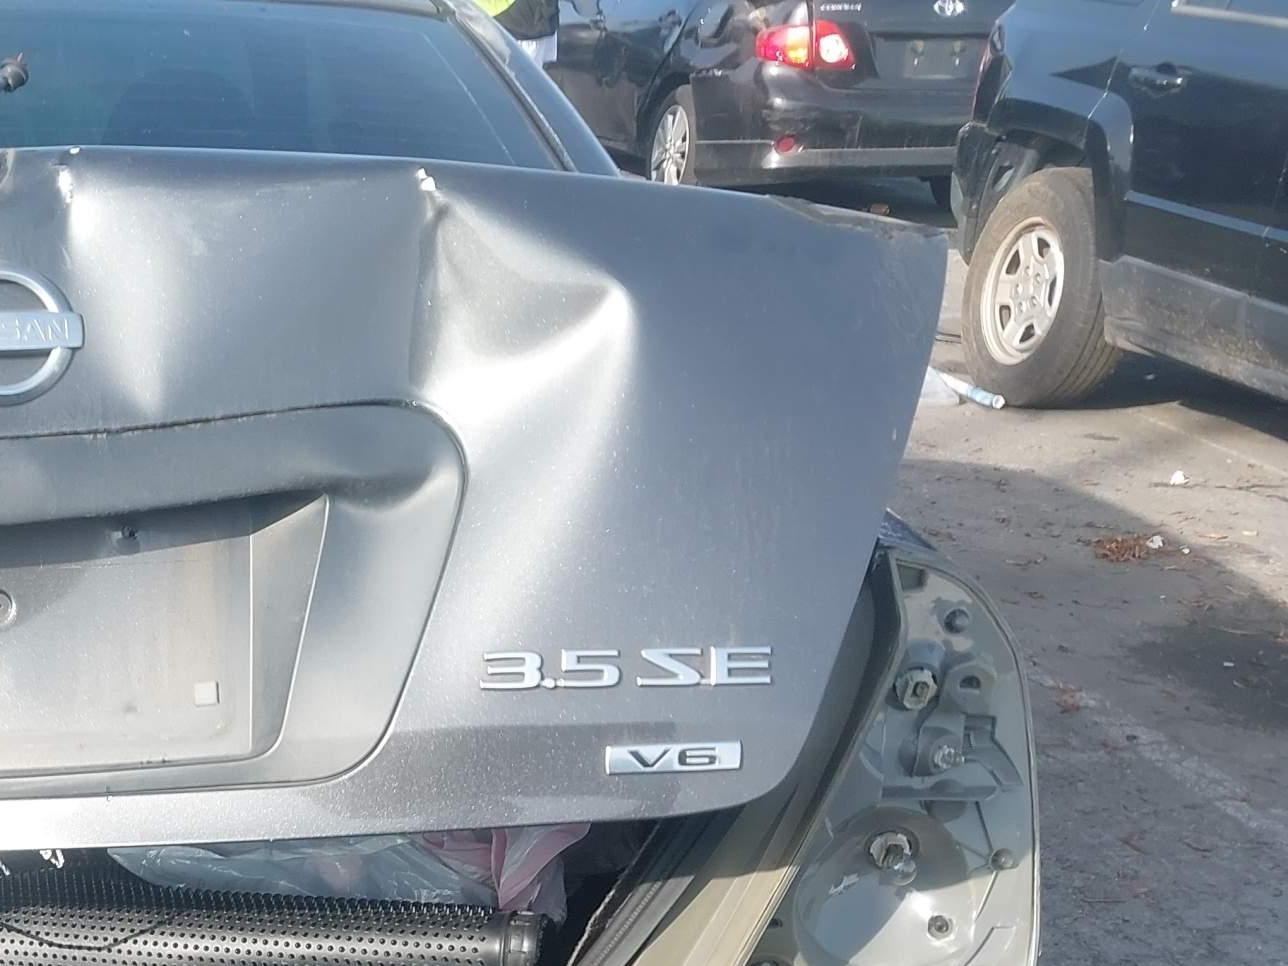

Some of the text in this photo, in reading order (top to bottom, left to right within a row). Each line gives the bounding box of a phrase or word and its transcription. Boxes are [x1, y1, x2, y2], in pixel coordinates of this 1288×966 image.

[479, 645, 772, 688] 3.5 SE
[626, 747, 718, 769] V6
